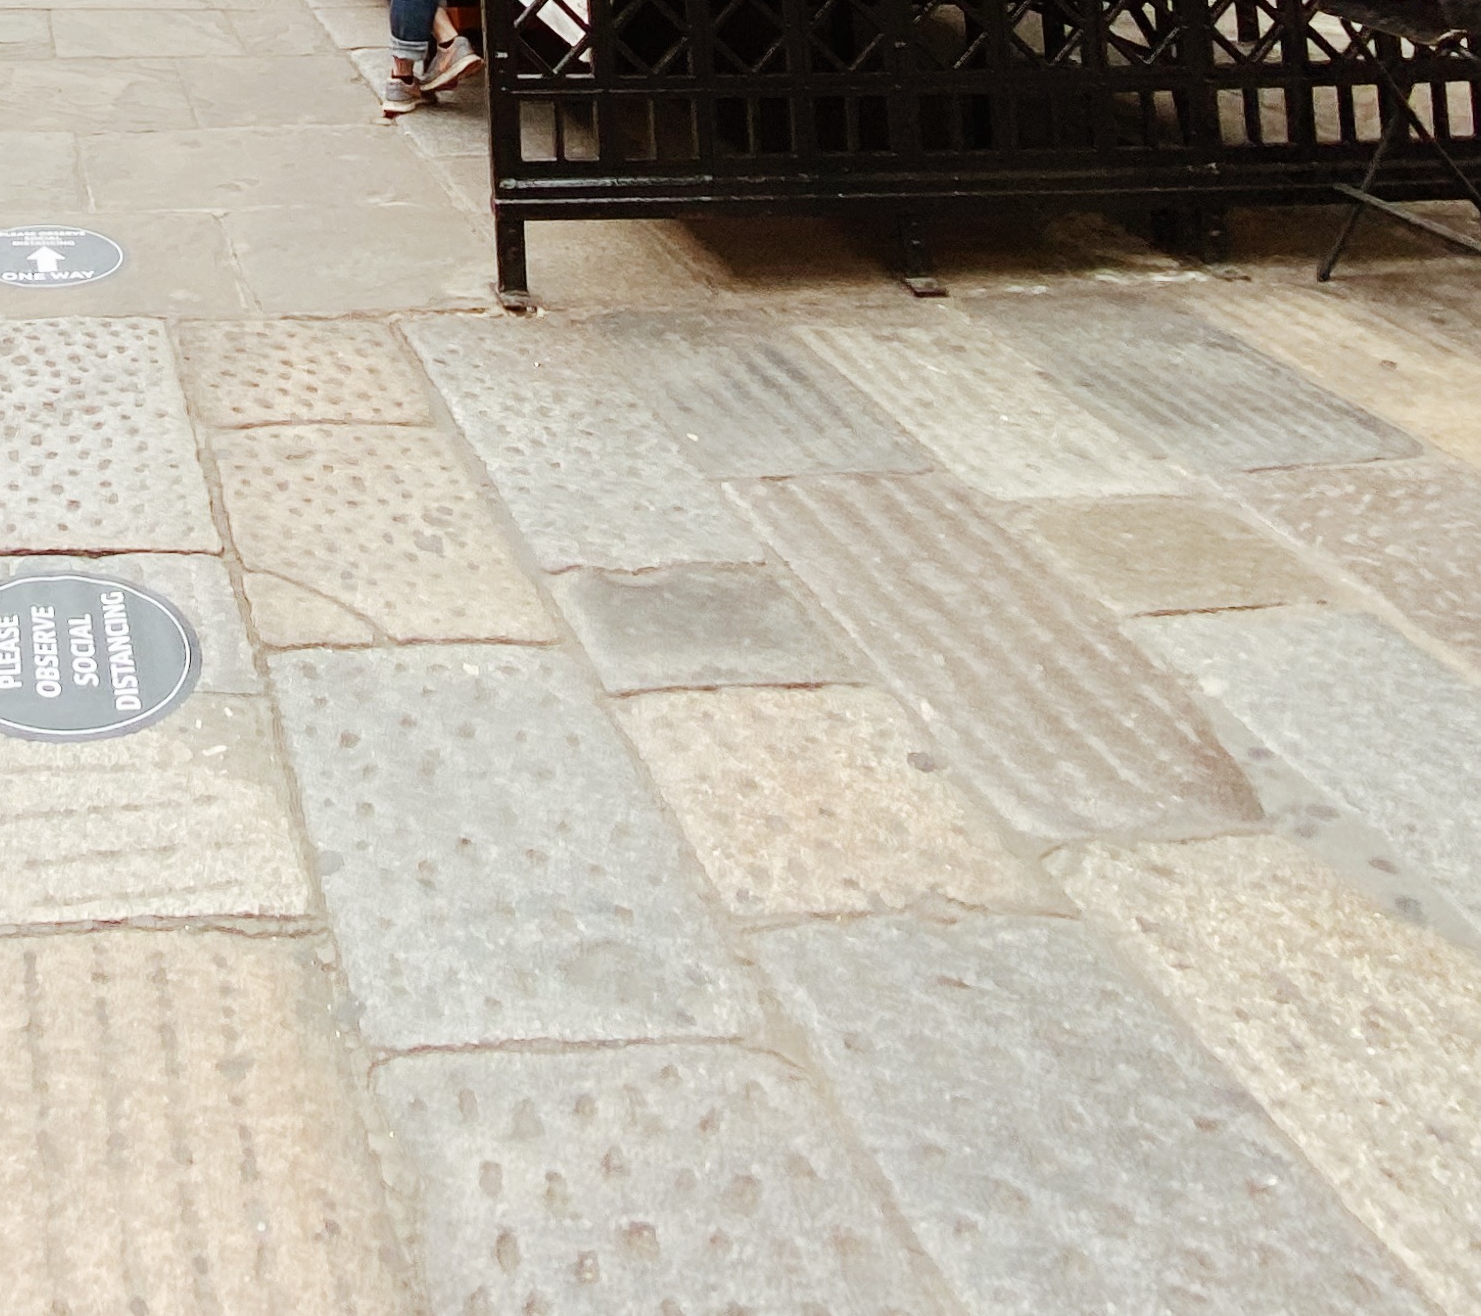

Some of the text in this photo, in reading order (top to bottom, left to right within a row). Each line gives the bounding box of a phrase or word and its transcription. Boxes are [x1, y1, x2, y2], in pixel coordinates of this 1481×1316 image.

[2, 270, 95, 281] ONE WAY
[30, 604, 62, 699] OBSERVE
[68, 613, 100, 687] SOCIAL
[100, 590, 143, 711] DISTANCING
